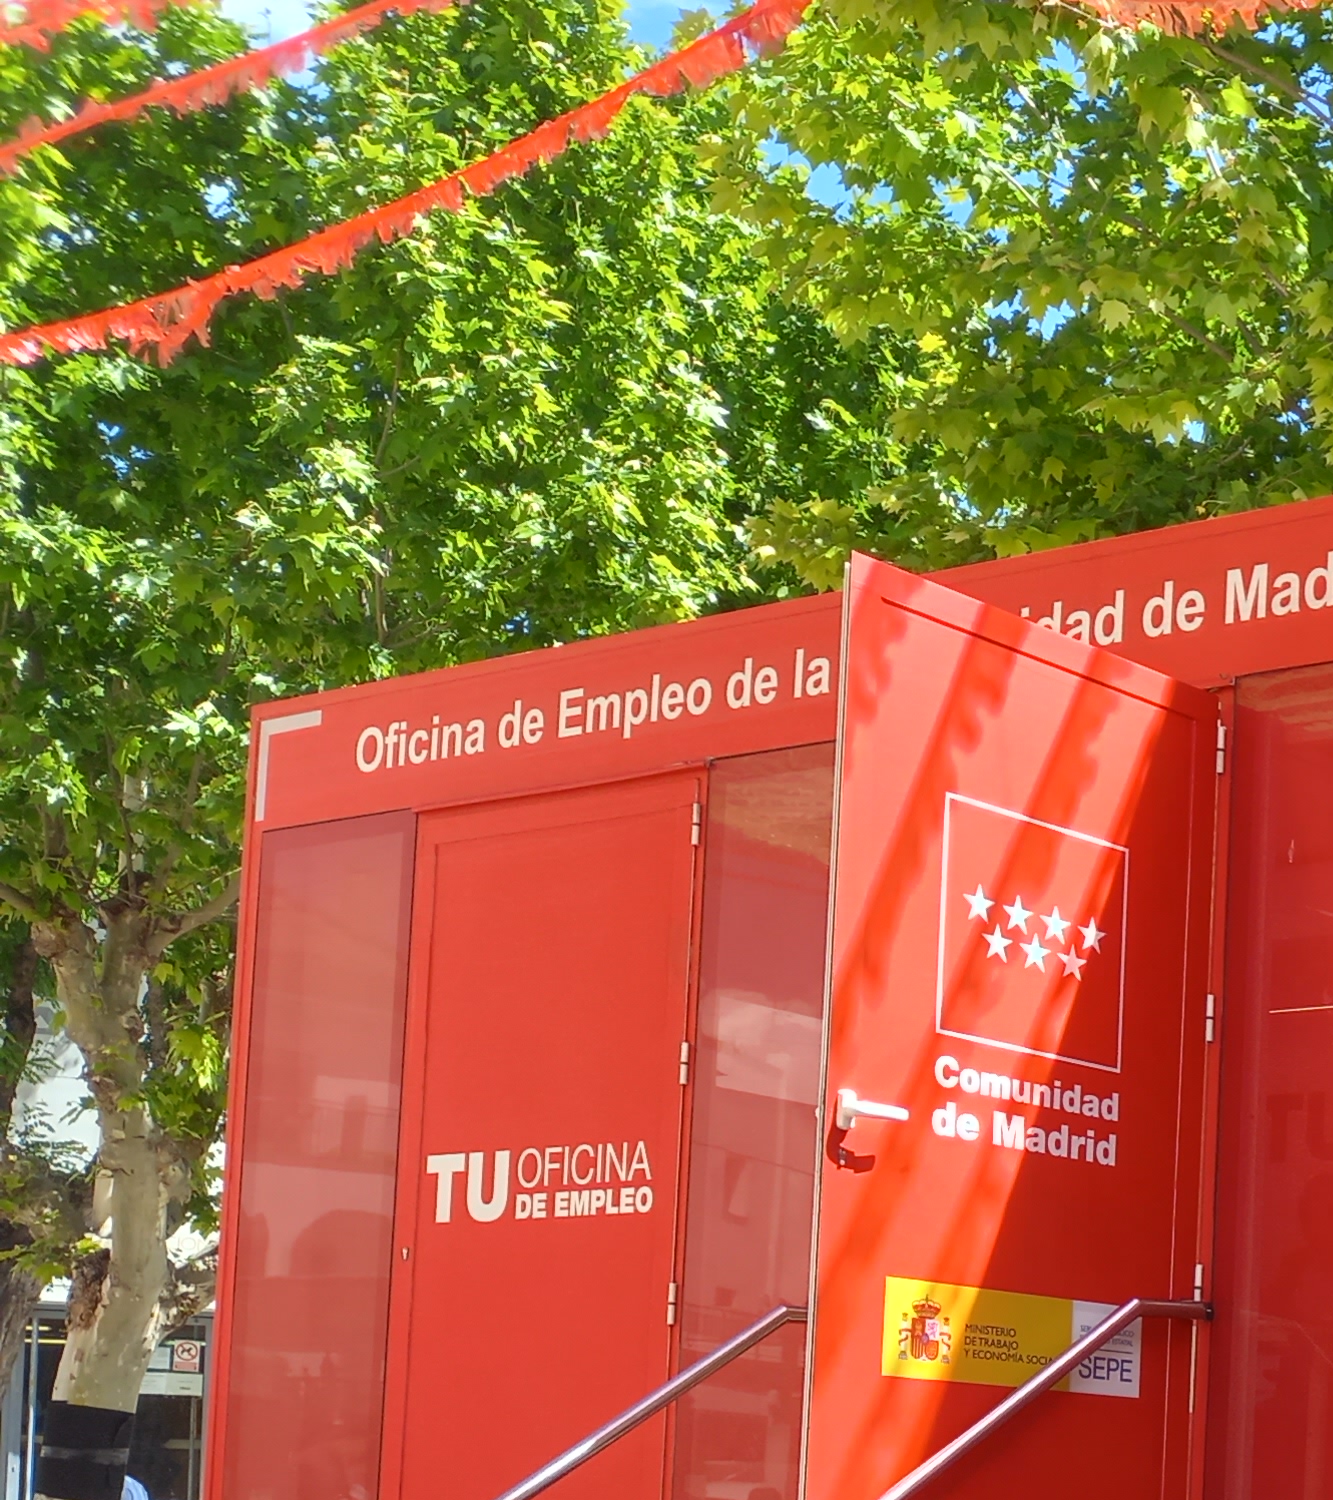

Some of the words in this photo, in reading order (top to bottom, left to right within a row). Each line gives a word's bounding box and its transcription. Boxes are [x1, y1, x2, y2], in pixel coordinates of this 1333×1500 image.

[1142, 580, 1205, 638] de
[355, 714, 485, 773] Oficina
[498, 700, 544, 748] de
[557, 674, 712, 739] Empleo
[726, 657, 778, 709] de
[793, 648, 830, 699] la
[934, 1055, 1119, 1122] Comunidad
[932, 1101, 980, 1141] de
[992, 1111, 1116, 1167] Madrid
[426, 1150, 511, 1223] TU
[517, 1140, 652, 1188] OFICINA
[515, 1192, 547, 1220] DE
[554, 1186, 653, 1218] EMPLEO
[964, 1336, 977, 1346] DE
[978, 1337, 1018, 1352] TRABAJO
[965, 1323, 1017, 1338] MINISTERIO
[964, 1348, 971, 1358] Y
[972, 1349, 1024, 1363] ECONOMÍA
[1078, 1355, 1133, 1382] SEPE
